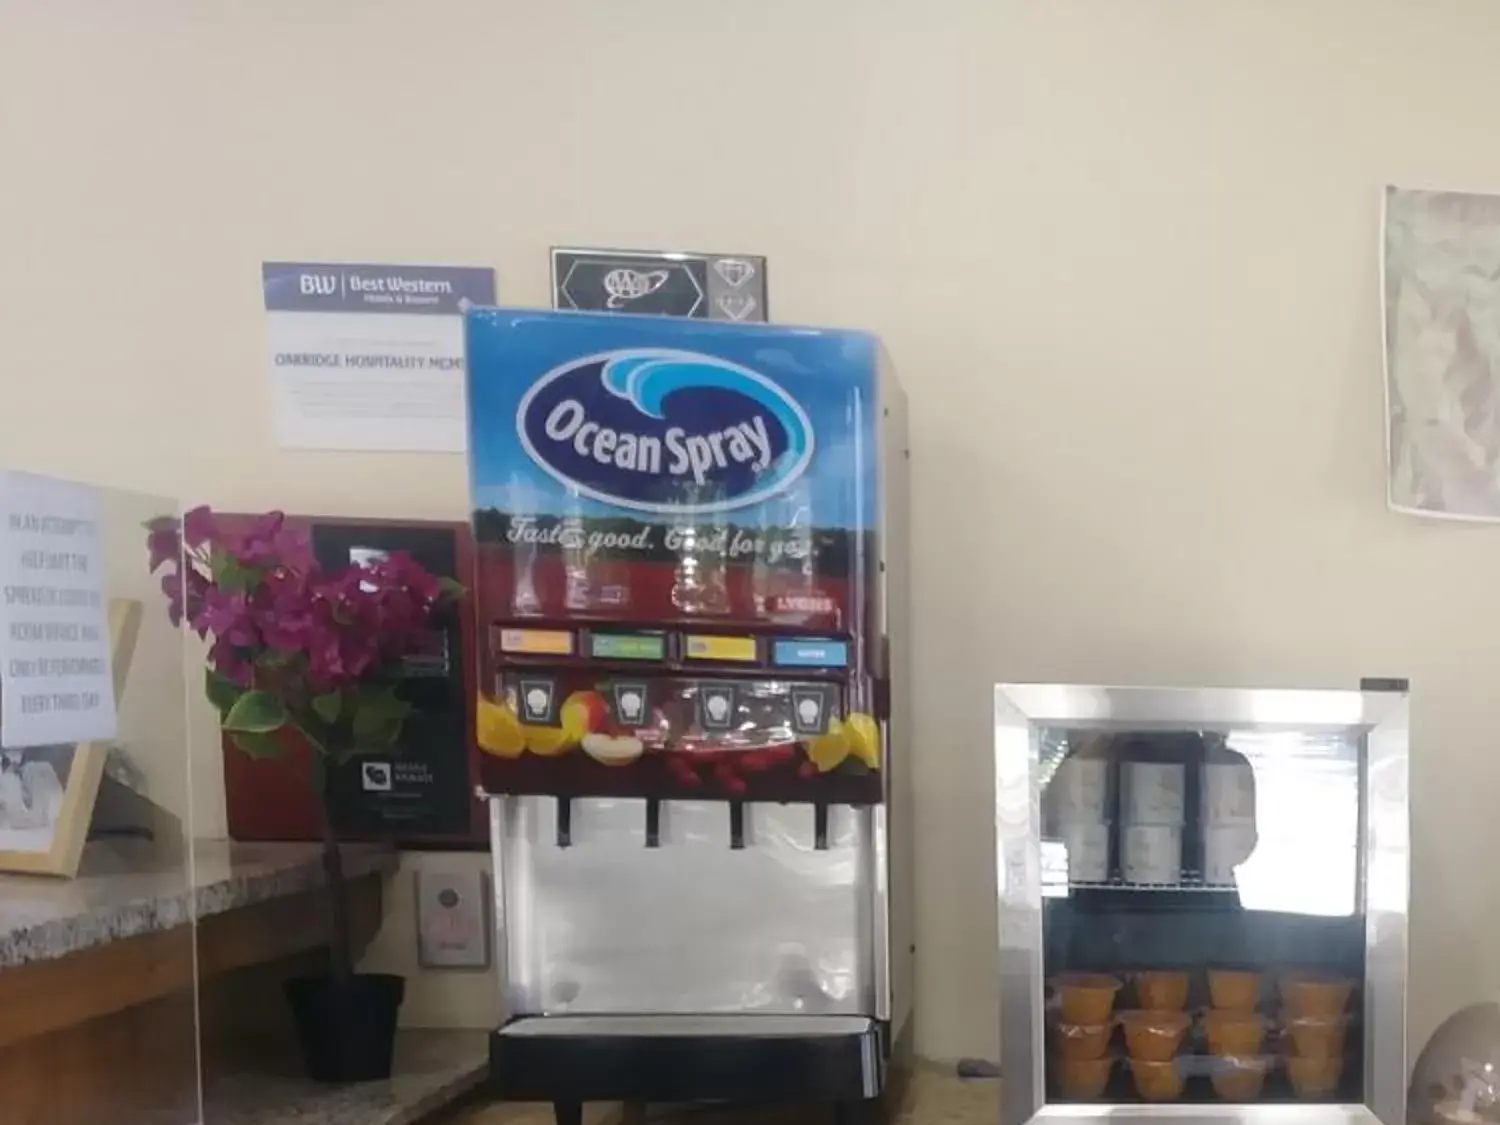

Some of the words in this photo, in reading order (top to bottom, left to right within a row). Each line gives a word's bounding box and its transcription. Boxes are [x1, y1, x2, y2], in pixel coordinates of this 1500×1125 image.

[300, 274, 336, 295] BW
[350, 275, 384, 293] Best
[386, 277, 452, 294] Western
[544, 399, 662, 474] Ocean
[664, 414, 772, 486] Spray
[506, 516, 585, 549] Tast
[587, 526, 654, 561] good.
